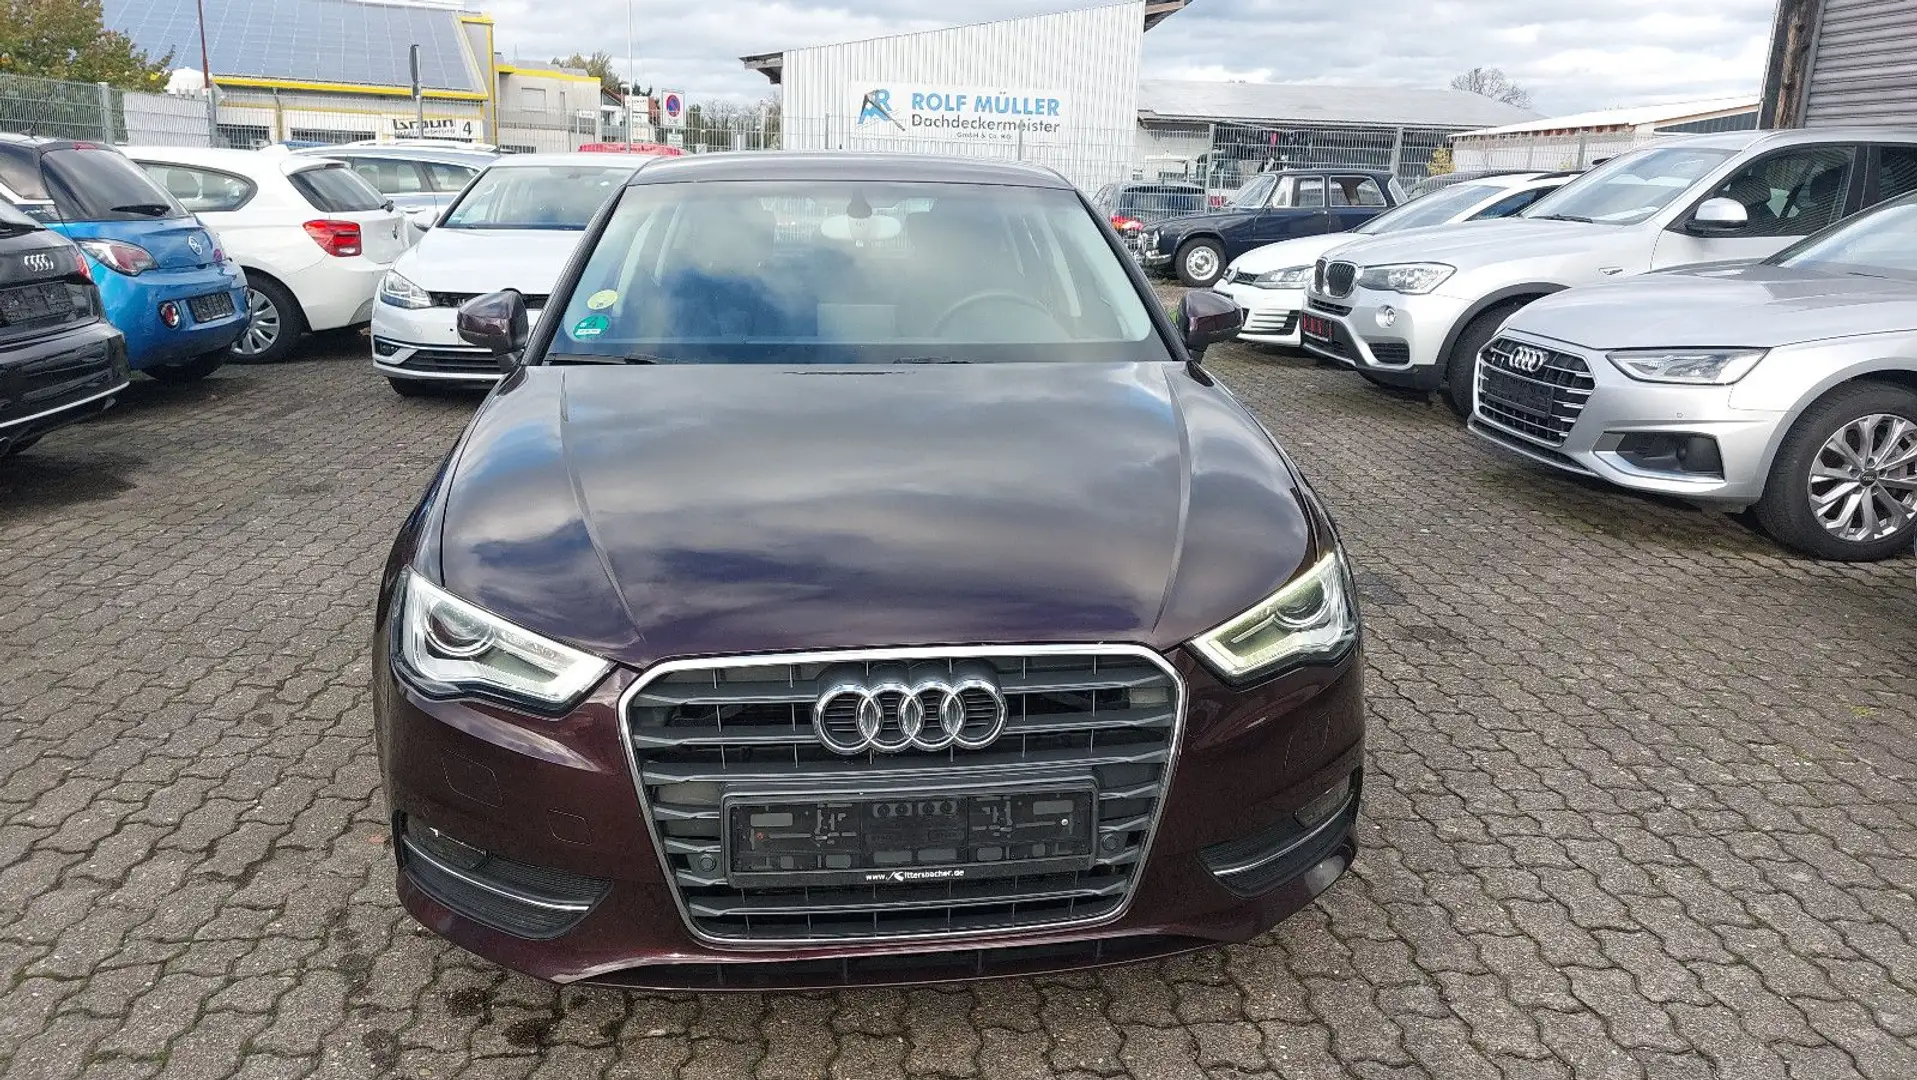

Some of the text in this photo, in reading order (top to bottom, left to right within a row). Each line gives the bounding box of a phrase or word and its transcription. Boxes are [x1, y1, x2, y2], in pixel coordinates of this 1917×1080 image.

[911, 91, 1060, 117] ROLF MÜLLER
[463, 121, 473, 137] 4
[911, 113, 1060, 133] Dachdeckermeister
